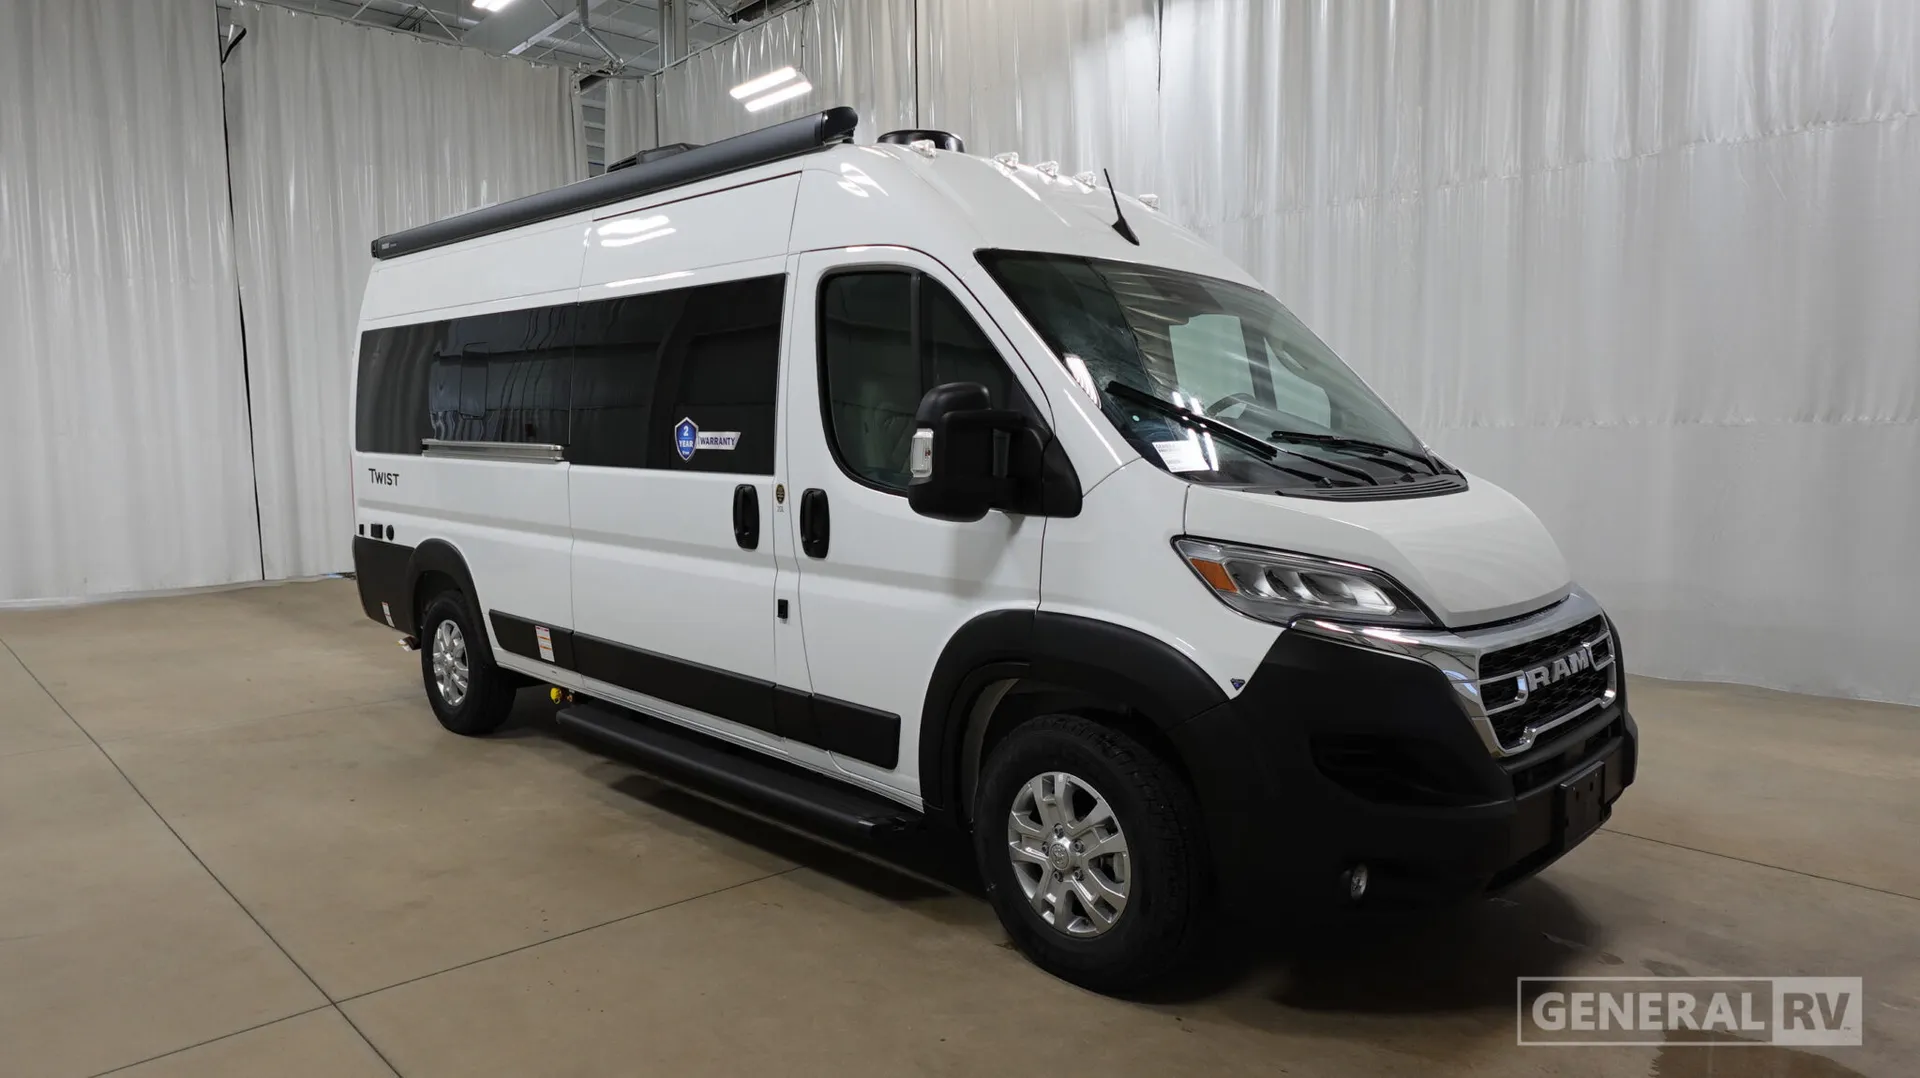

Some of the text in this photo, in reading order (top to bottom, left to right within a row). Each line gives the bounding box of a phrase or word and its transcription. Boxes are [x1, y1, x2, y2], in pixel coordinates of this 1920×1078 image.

[683, 425, 689, 436] 2
[679, 440, 694, 448] YEAR
[700, 436, 736, 446] WARRANTY
[368, 468, 399, 486] TWIST
[1525, 648, 1589, 692] RAM
